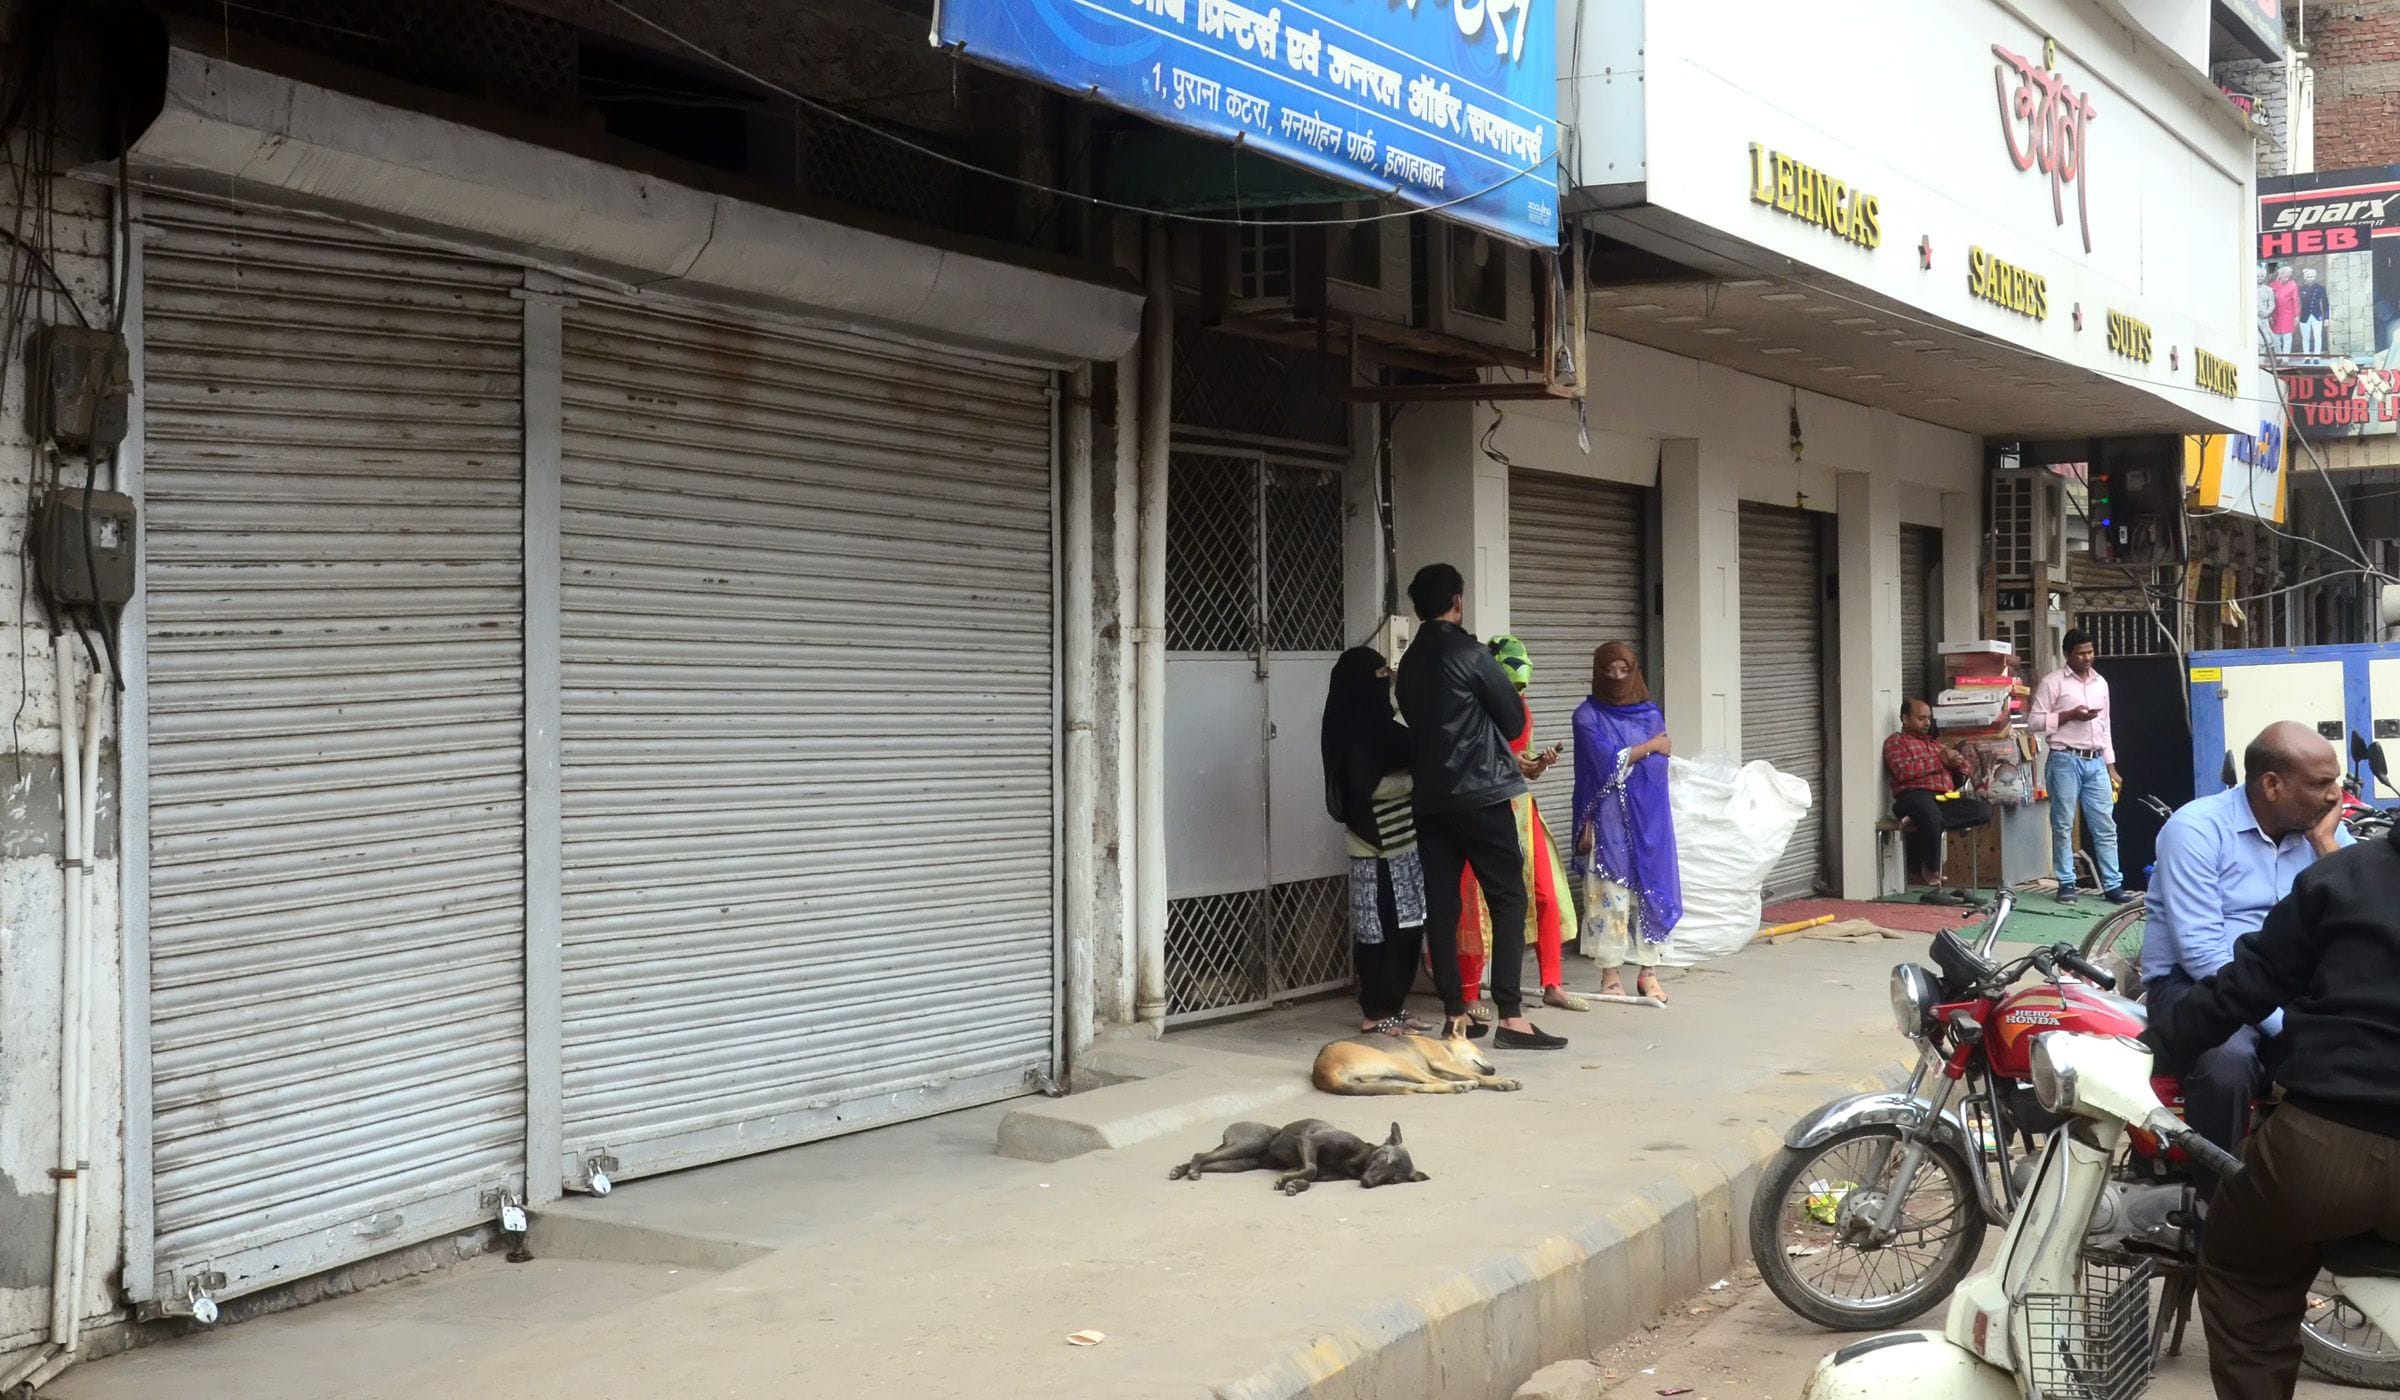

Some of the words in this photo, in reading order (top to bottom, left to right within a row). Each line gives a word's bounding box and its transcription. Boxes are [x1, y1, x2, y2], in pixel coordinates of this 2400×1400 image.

[1285, 25, 1322, 77] एवं
[1327, 44, 1402, 110] जनरल
[1408, 73, 1463, 135] ऑर्डर
[1466, 103, 1544, 165] सप्लायर्स
[1152, 62, 1168, 98] 1,
[1172, 66, 1221, 109] पुराना
[1226, 86, 1273, 132] कटरा,
[1281, 106, 1343, 154] मनमोहन
[1347, 128, 1378, 171] पार्क,
[1383, 145, 1446, 190] इलाहाबाद
[2272, 193, 2400, 231] sparx
[2262, 227, 2359, 259] HEB
[1748, 141, 1882, 251] LEHNGAS
[1967, 244, 2048, 322] SAREES
[2106, 306, 2153, 364] SUITS
[2195, 346, 2239, 399] KURTIS
[2304, 398, 2370, 426] YOUR
[2005, 1015, 2061, 1026] HONDA
[2015, 1010, 2050, 1018] HERO
